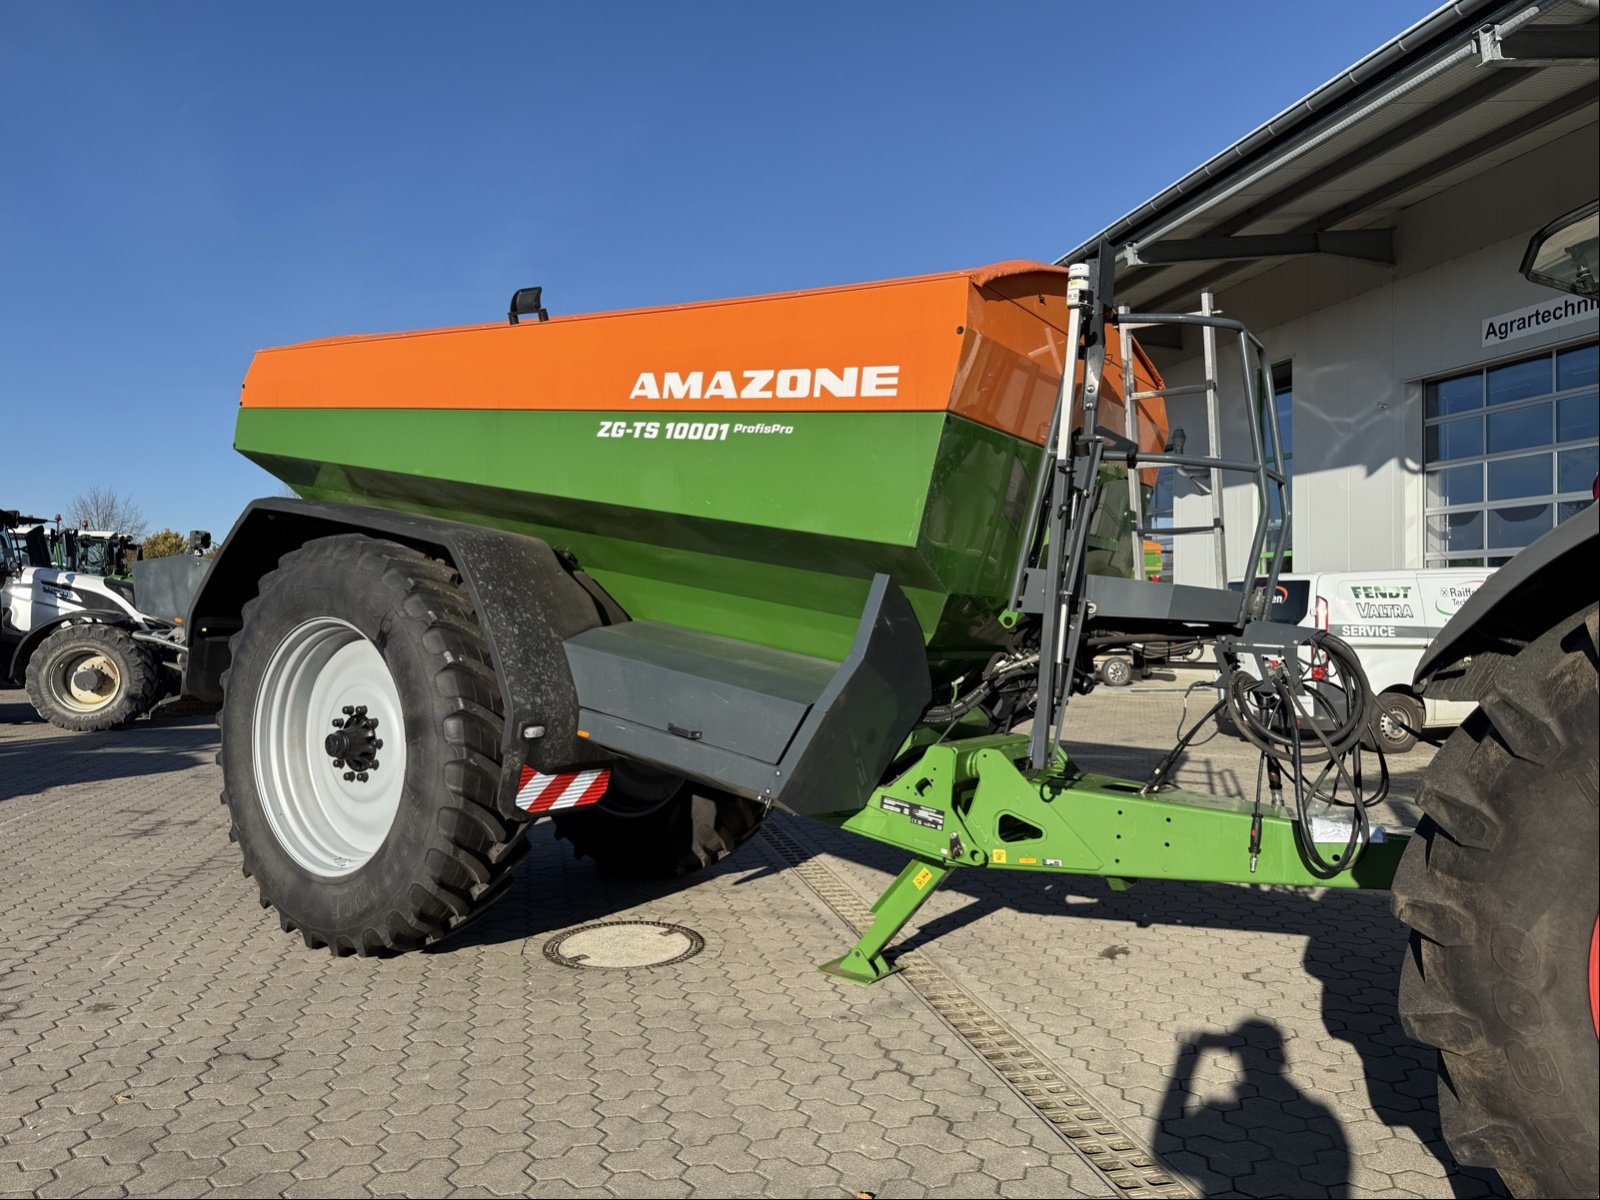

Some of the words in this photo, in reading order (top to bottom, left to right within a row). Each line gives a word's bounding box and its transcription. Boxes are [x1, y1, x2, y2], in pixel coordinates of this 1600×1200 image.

[628, 365, 900, 400] AMAZONE
[597, 421, 660, 438] ZG-TS
[665, 422, 730, 441] 10001
[733, 423, 794, 434] ProfisPro
[1350, 586, 1412, 599] FENDT
[1355, 602, 1414, 619] VALTRA
[1341, 625, 1396, 637] SERVICE
